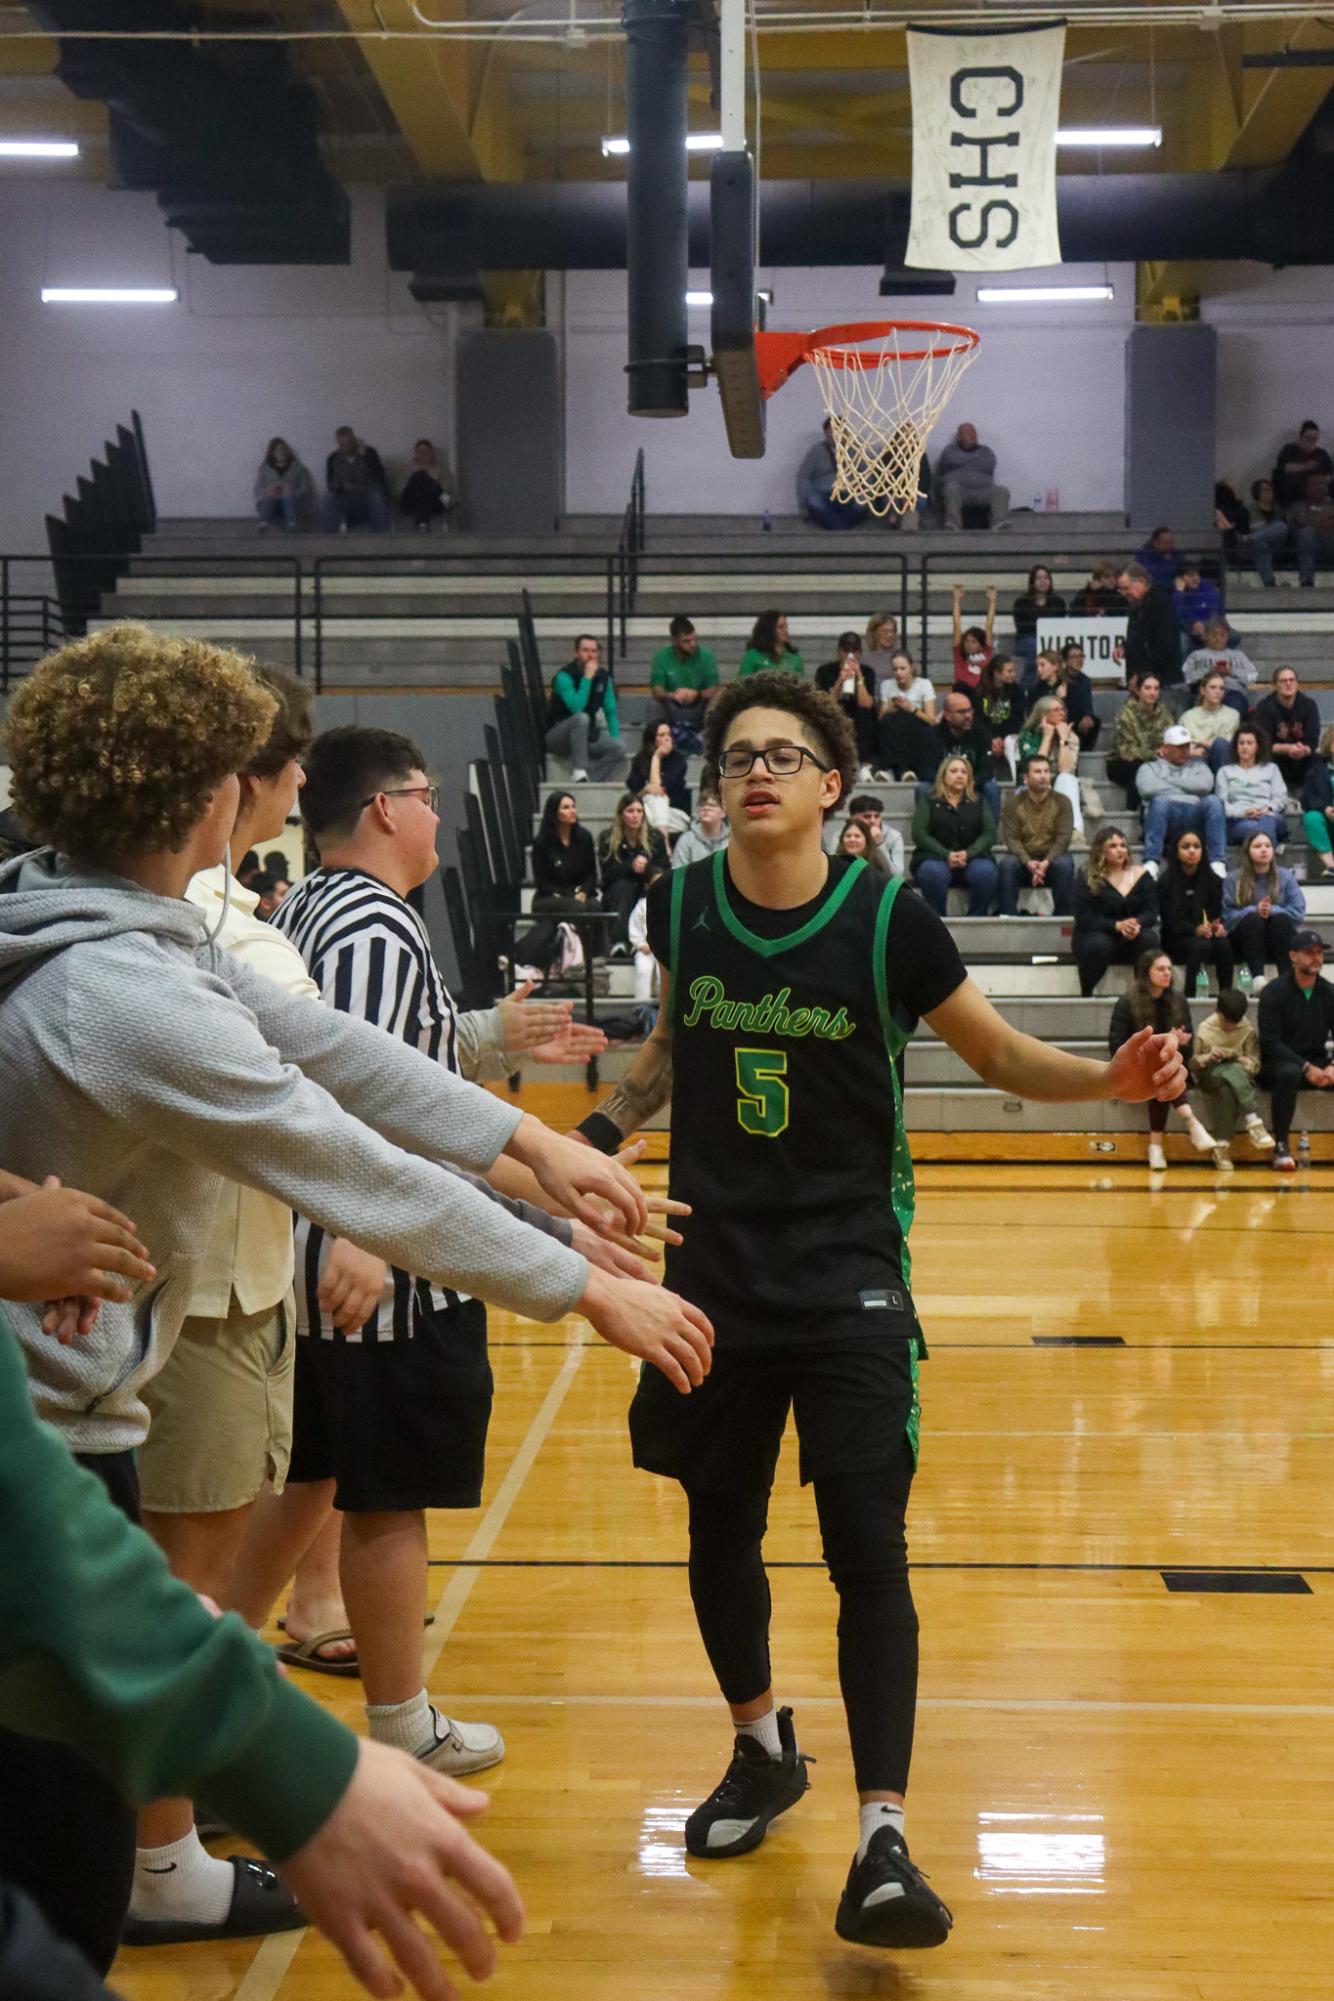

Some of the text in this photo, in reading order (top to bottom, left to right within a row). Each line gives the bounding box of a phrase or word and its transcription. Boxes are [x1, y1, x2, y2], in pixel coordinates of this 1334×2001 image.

[950, 65, 1024, 249] CHS
[683, 975, 856, 1040] Panthers
[734, 1047, 789, 1137] 5
[891, 1295, 898, 1305] L
